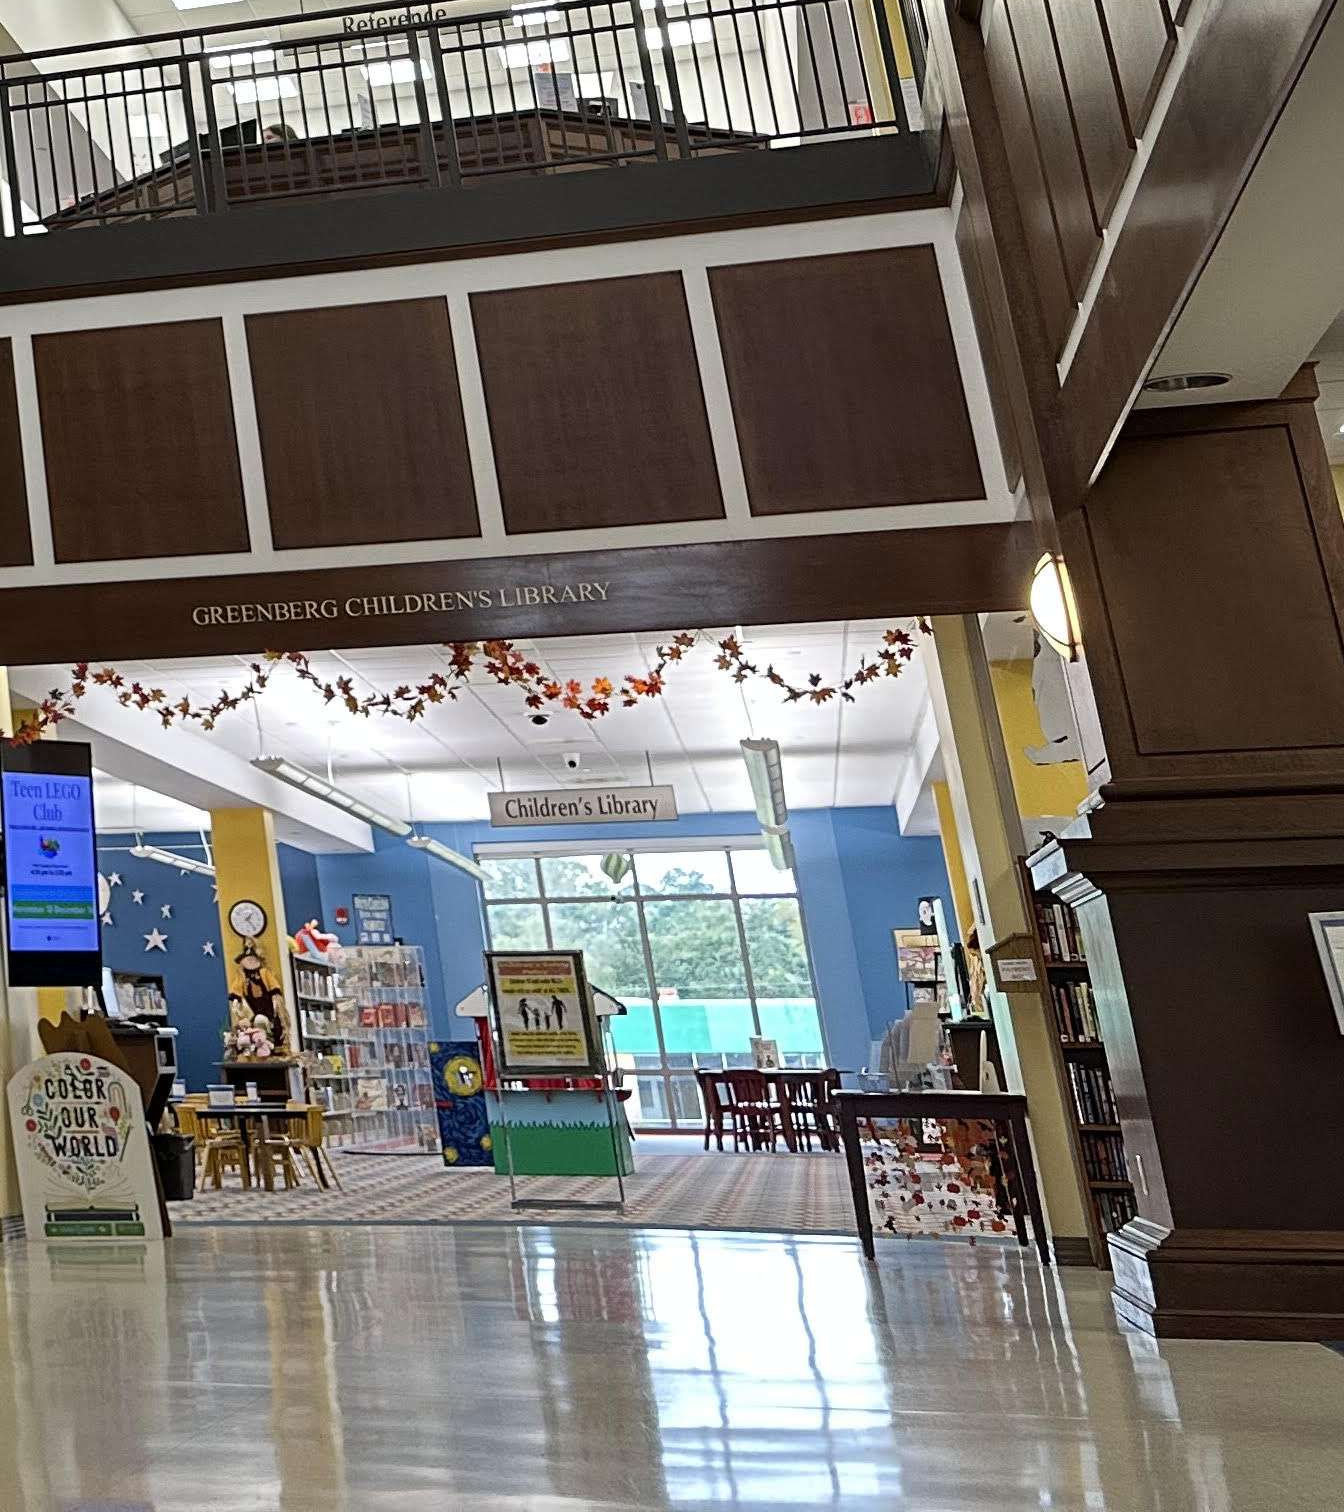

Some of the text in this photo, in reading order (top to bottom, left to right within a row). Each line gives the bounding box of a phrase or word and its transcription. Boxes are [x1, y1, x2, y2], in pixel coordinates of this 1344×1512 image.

[192, 581, 610, 626] GREENBERG CHILDREN'S LIBRARY
[10, 780, 81, 800] Teen LEGO
[33, 802, 62, 821] Club
[505, 794, 658, 820] Children's Library
[44, 1078, 106, 1100] COLOR
[62, 1106, 99, 1129] OUR
[51, 1137, 118, 1158] WORLD
